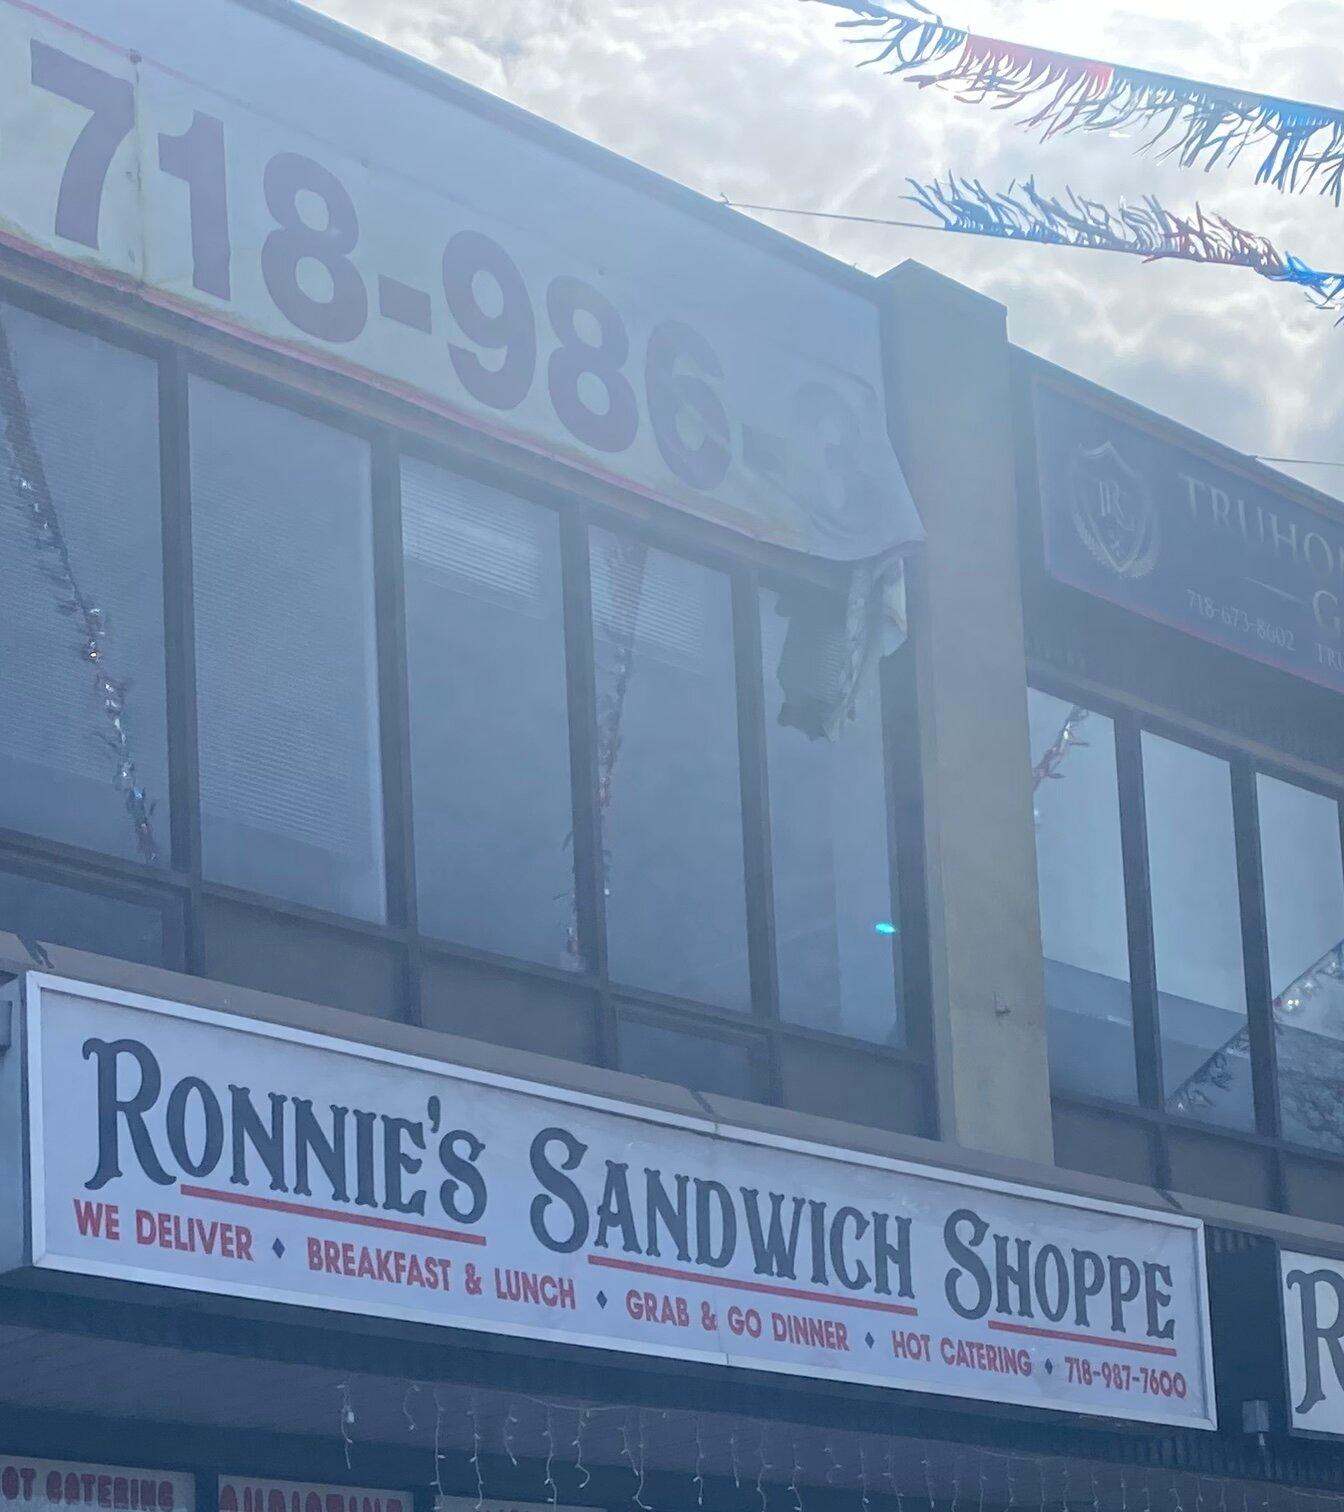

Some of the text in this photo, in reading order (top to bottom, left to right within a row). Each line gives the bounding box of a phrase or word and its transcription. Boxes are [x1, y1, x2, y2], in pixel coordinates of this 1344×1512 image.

[82, 1037, 1176, 1340] RONNIE'S SANDWICH SHOPPE
[73, 1199, 1188, 1399] WE DELIVER BREAKFAST & LUNCH GRAB & GO DINNER HOT CATERING 718-987-7600
[46, 1470, 175, 1512] CATERING
